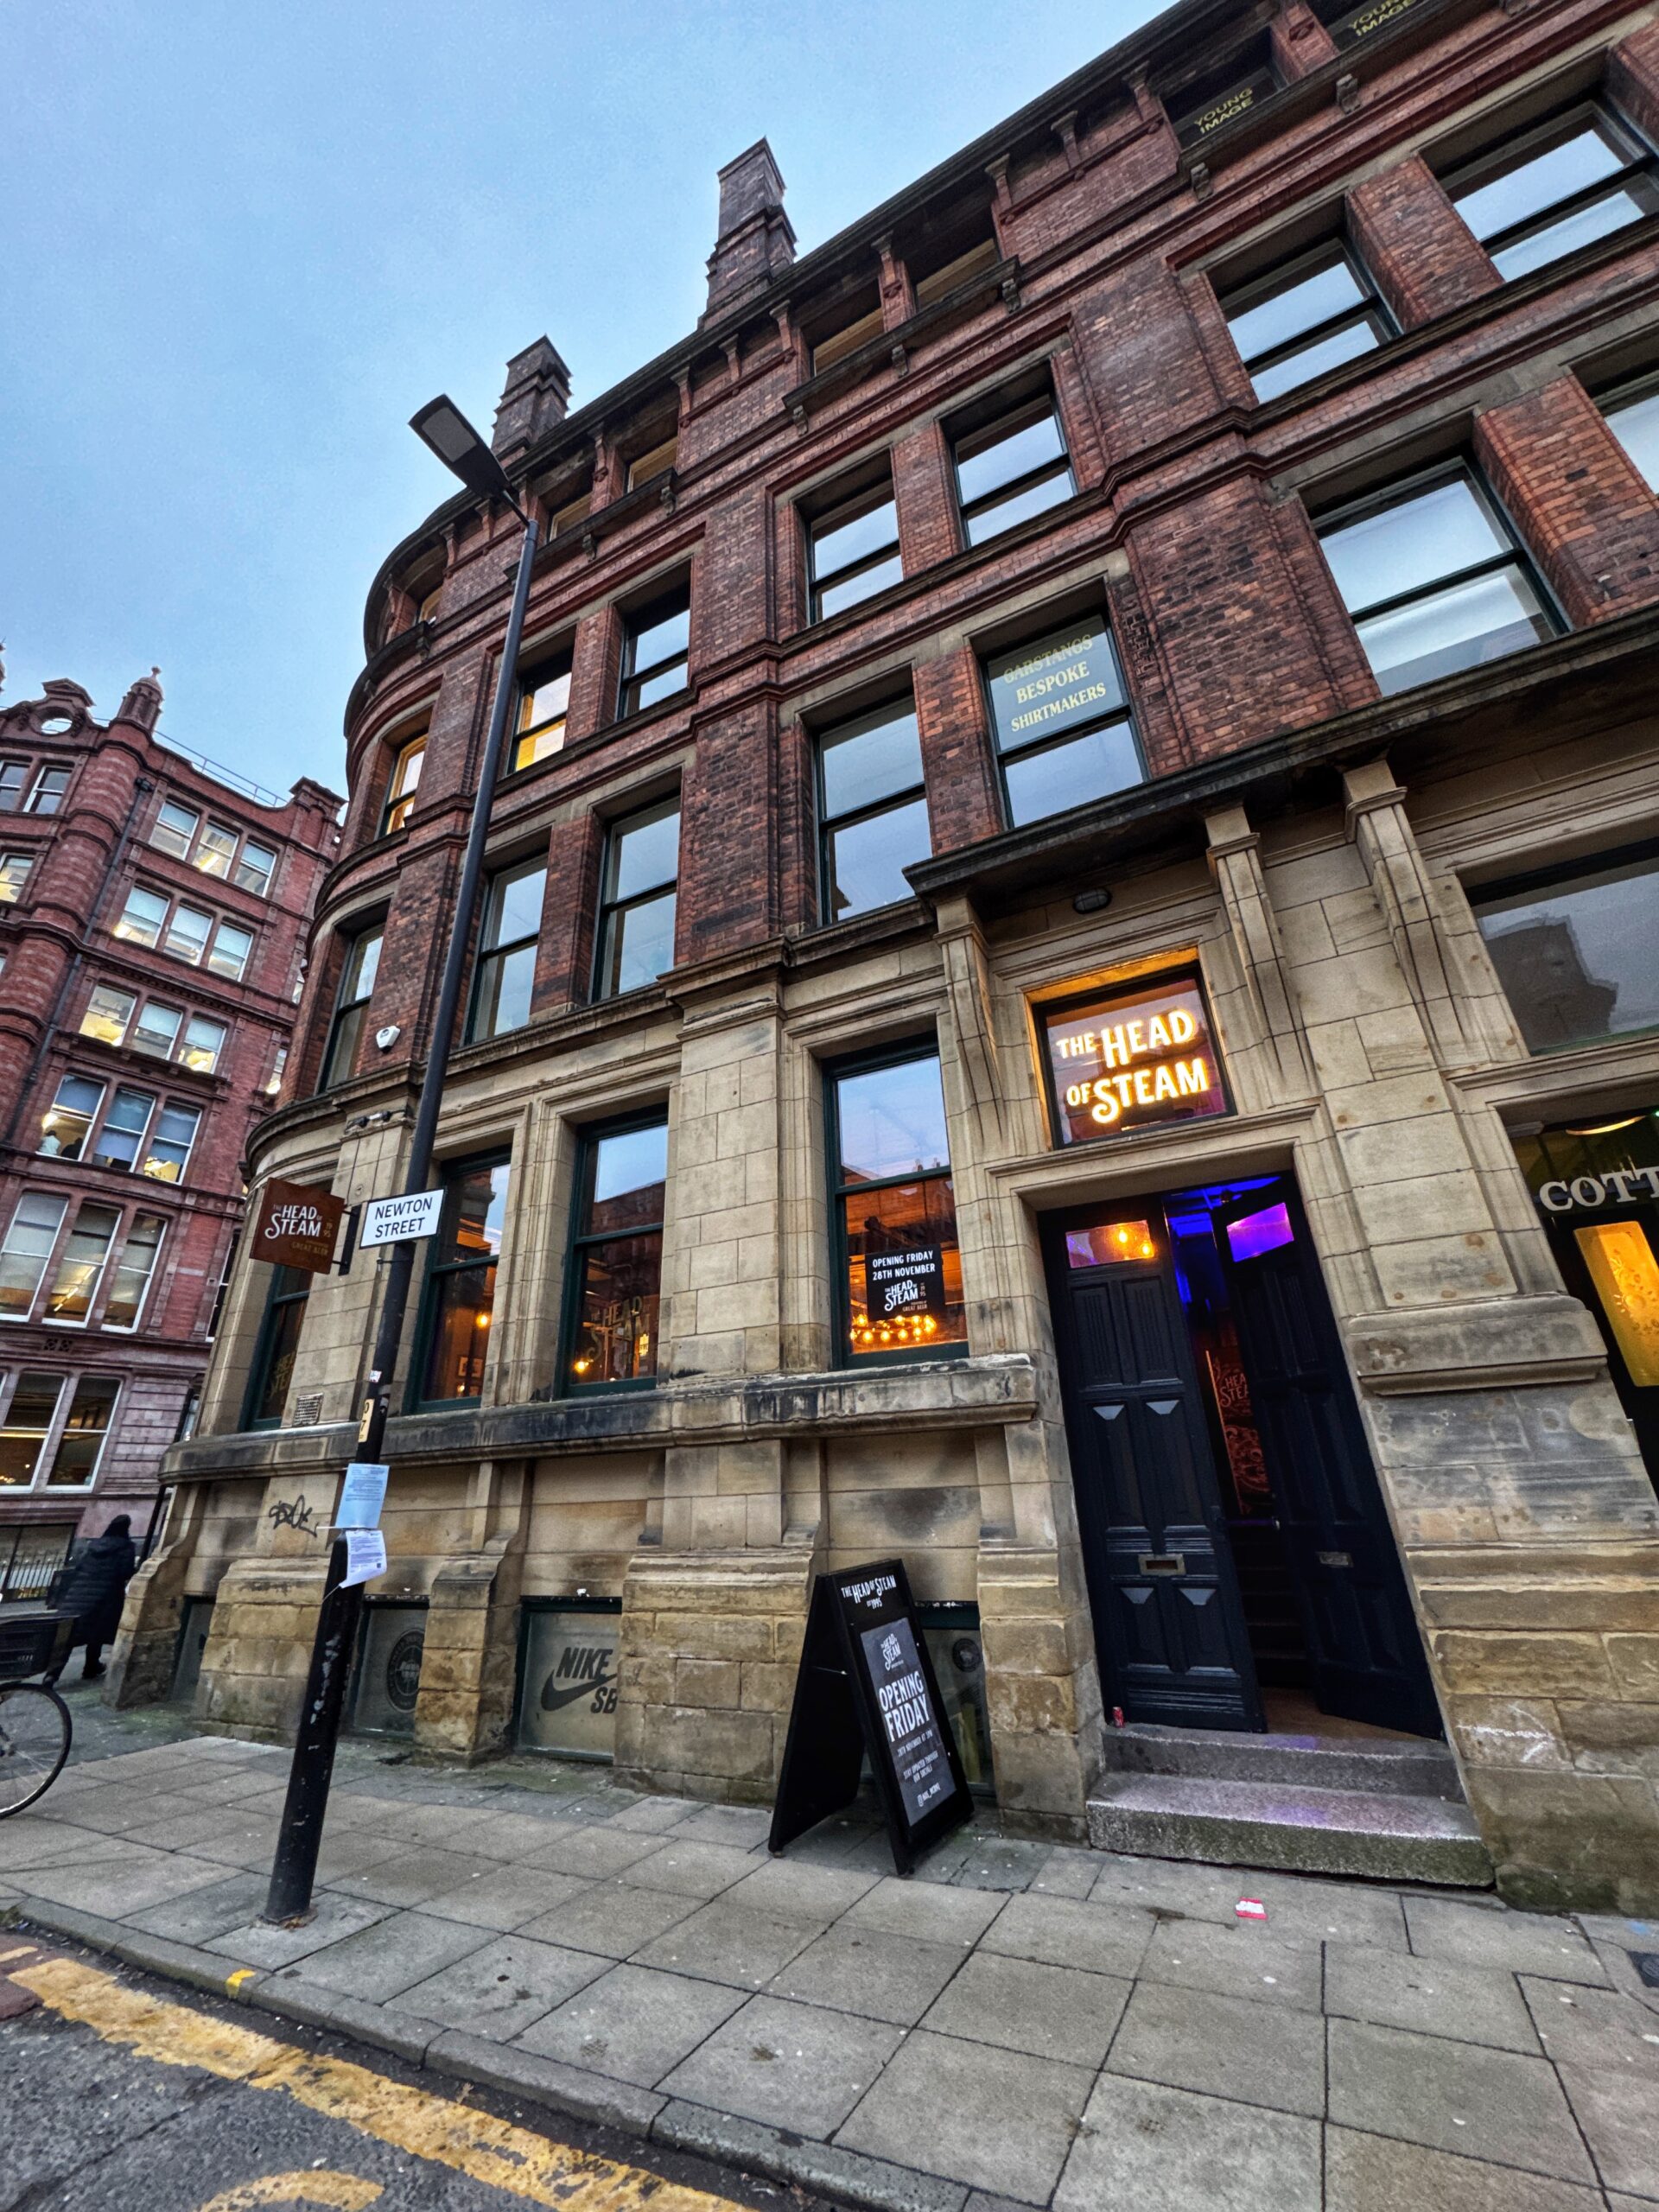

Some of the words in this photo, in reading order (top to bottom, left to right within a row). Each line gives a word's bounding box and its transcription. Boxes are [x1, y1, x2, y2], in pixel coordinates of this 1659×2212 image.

[1193, 87, 1253, 126] YOUNG
[1199, 97, 1254, 134] IMAGE
[1016, 660, 1090, 704] BESPOKE
[1011, 683, 1106, 732] SHIRTMAKERS
[1056, 1032, 1097, 1059] THE
[1101, 1008, 1196, 1069] HEAD
[1066, 1082, 1091, 1107] OF
[1090, 1058, 1210, 1124] STEAM
[281, 1205, 318, 1220] HEAD
[374, 1197, 433, 1220] NEWTON
[264, 1212, 322, 1240] STEAM
[375, 1217, 426, 1239] STREET
[872, 1255, 905, 1268] OPENING
[906, 1250, 933, 1263] FRIDAY
[872, 1269, 893, 1281] 28TH
[894, 1263, 936, 1278] NOVEMBER
[884, 1287, 918, 1312] STEAM
[891, 1280, 913, 1295] HEAD
[841, 1586, 853, 1599] THE
[851, 1581, 871, 1605] HEAD
[874, 1574, 897, 1597] STEAM
[556, 1646, 613, 1680] NIKE
[882, 1642, 901, 1671] STEAM
[590, 1686, 618, 1713] SB
[879, 1670, 924, 1712] OPENING
[884, 1693, 930, 1743] FRIDAY
